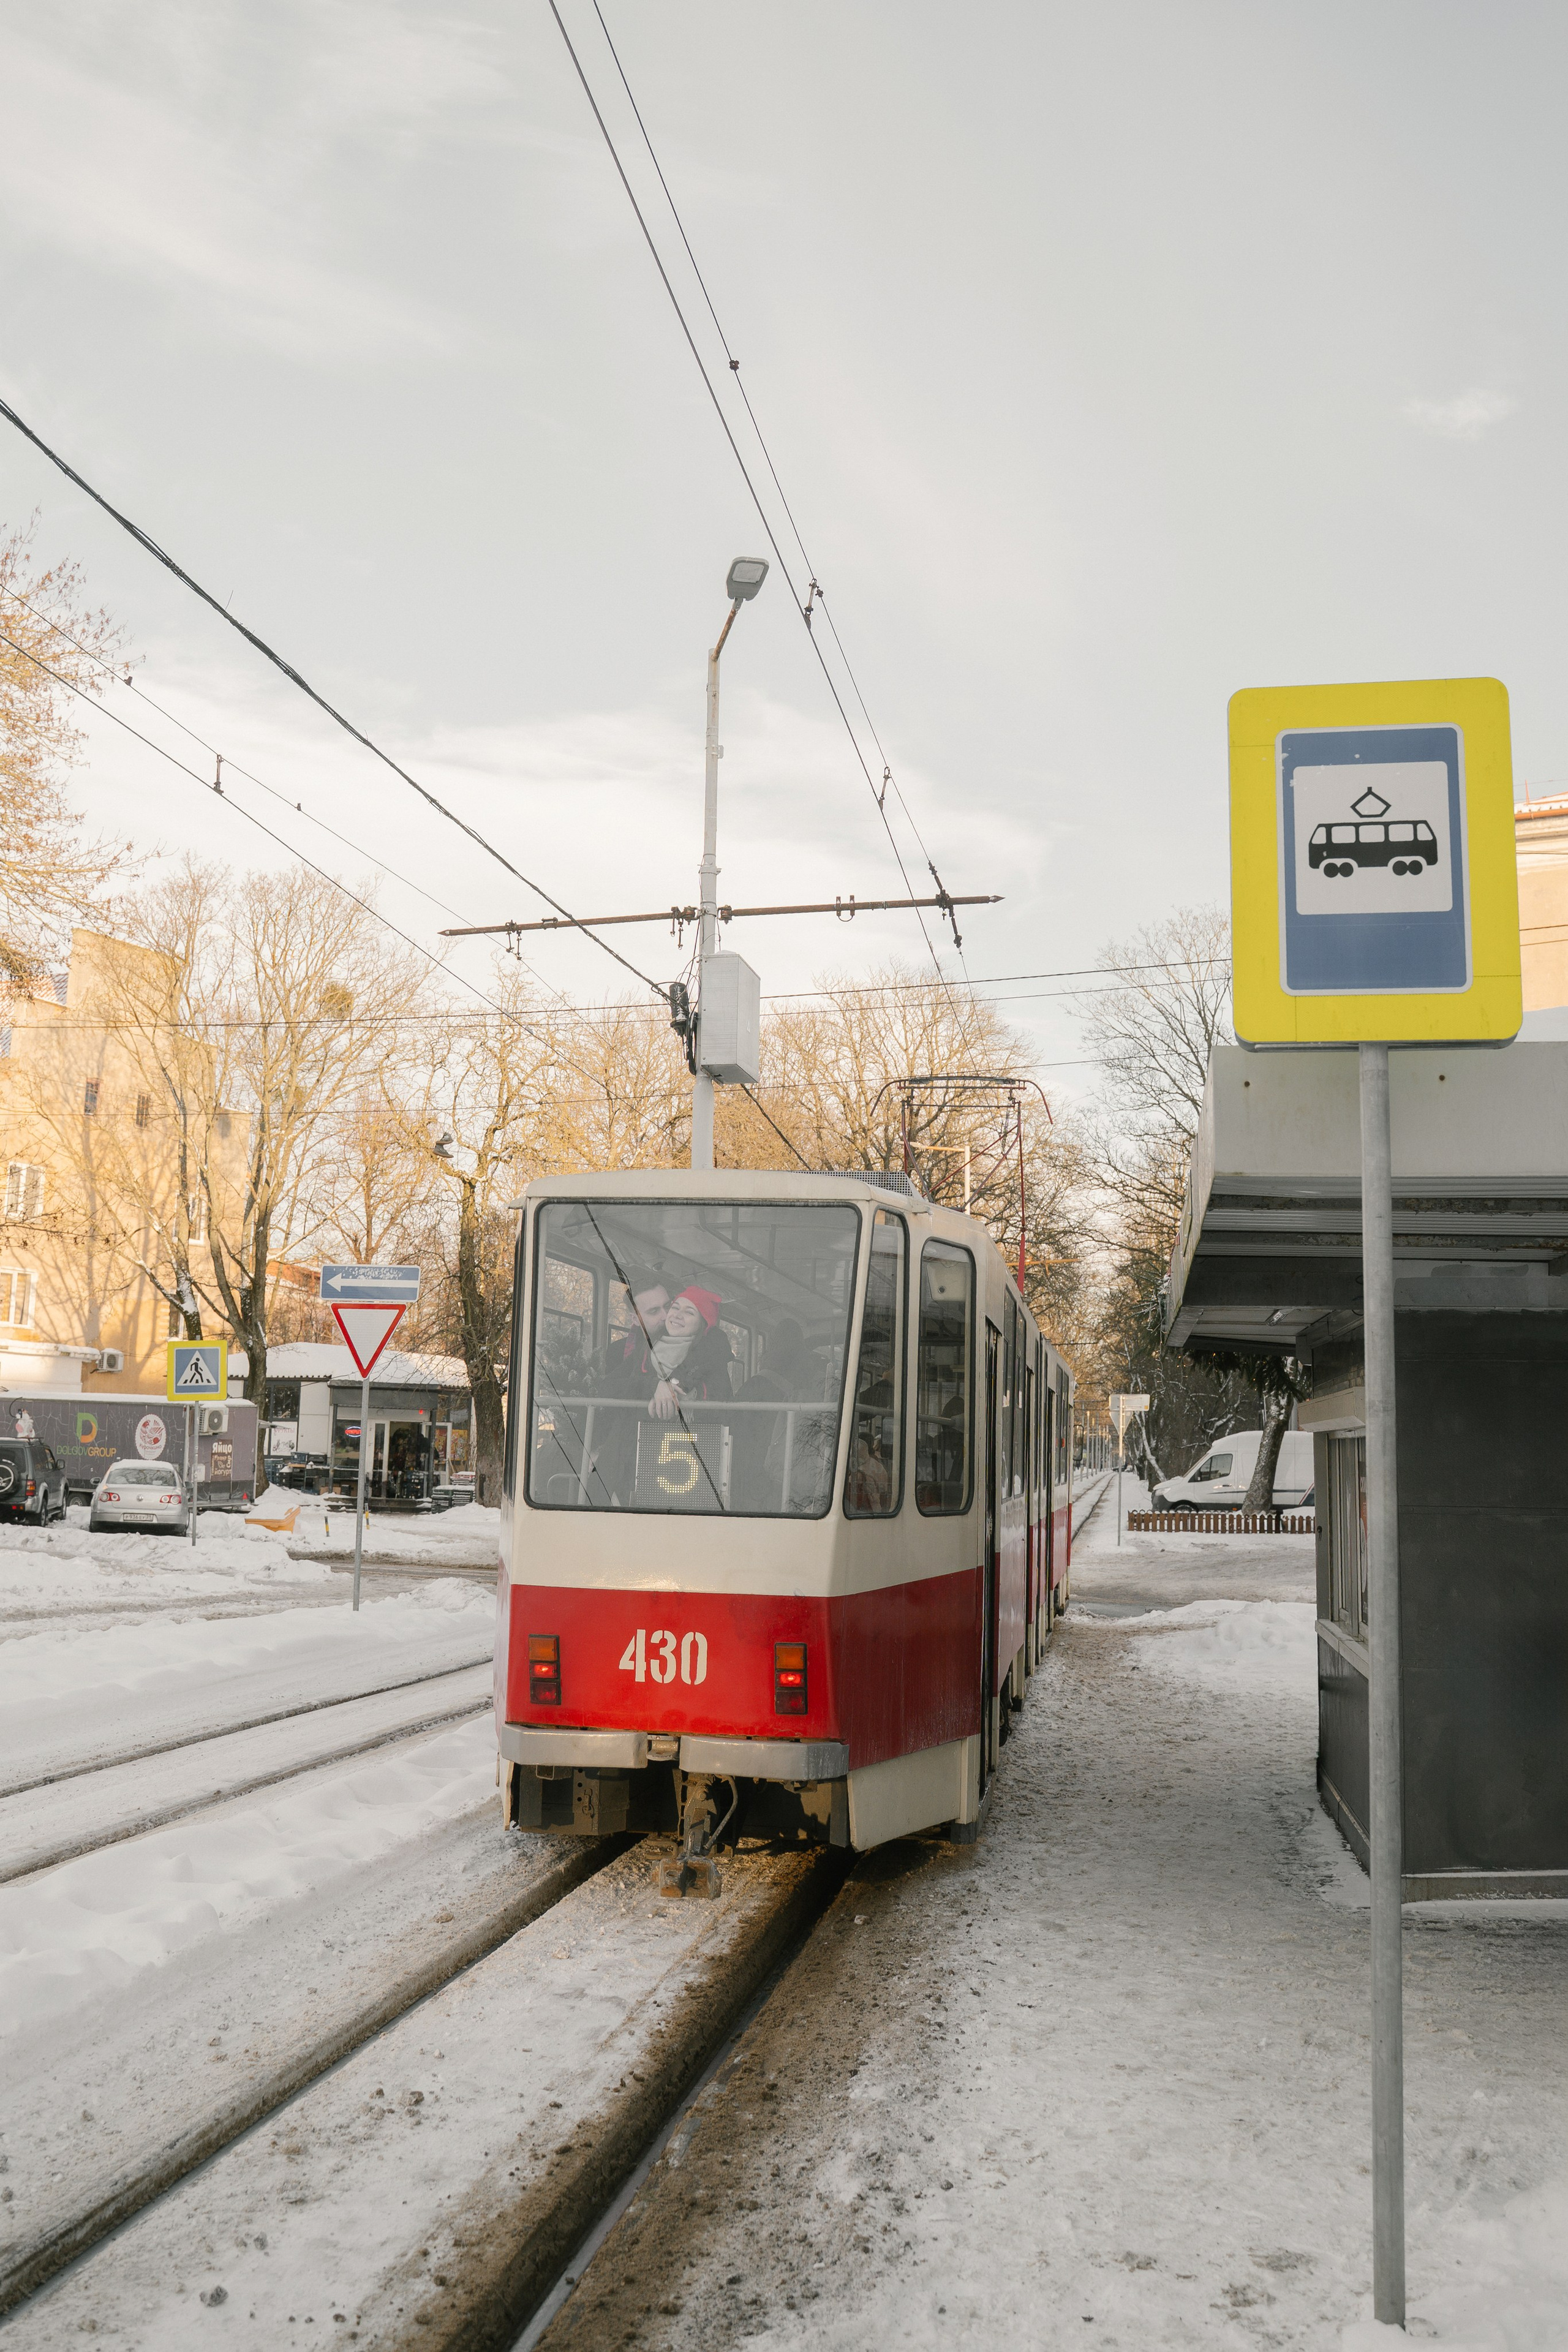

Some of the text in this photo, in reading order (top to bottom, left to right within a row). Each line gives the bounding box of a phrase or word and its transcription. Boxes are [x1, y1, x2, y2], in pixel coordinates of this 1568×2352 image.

[212, 1442, 232, 1454] Яйцо
[657, 1433, 699, 1493] 5
[618, 1629, 708, 1686] 430
